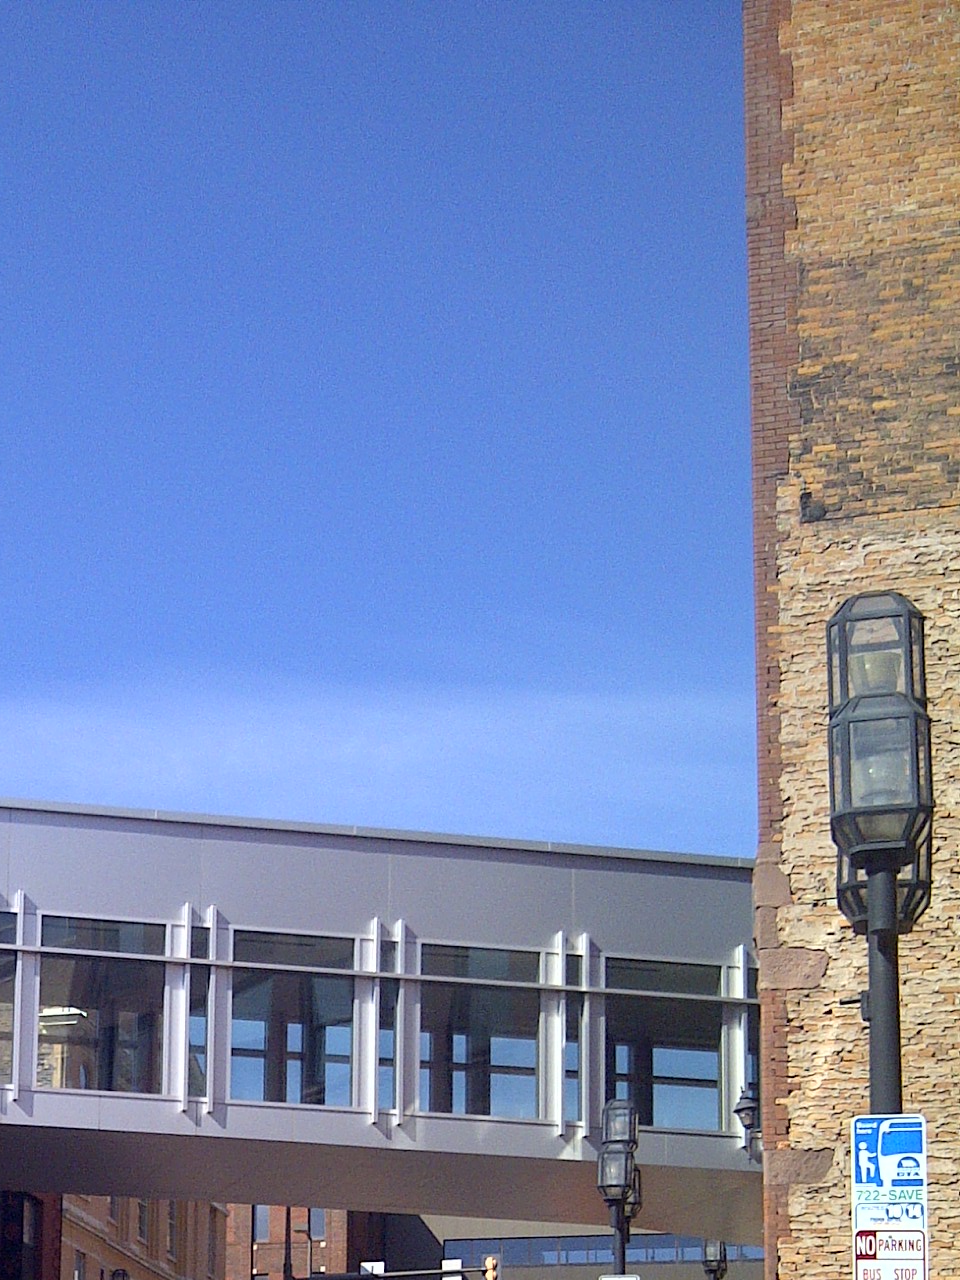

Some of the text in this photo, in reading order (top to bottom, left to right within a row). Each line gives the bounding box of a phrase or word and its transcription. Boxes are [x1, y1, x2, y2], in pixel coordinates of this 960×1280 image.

[856, 1189, 923, 1201] 722-SAVE
[856, 1235, 922, 1256] NO PARKING
[863, 1268, 917, 1280] BUS STOP
